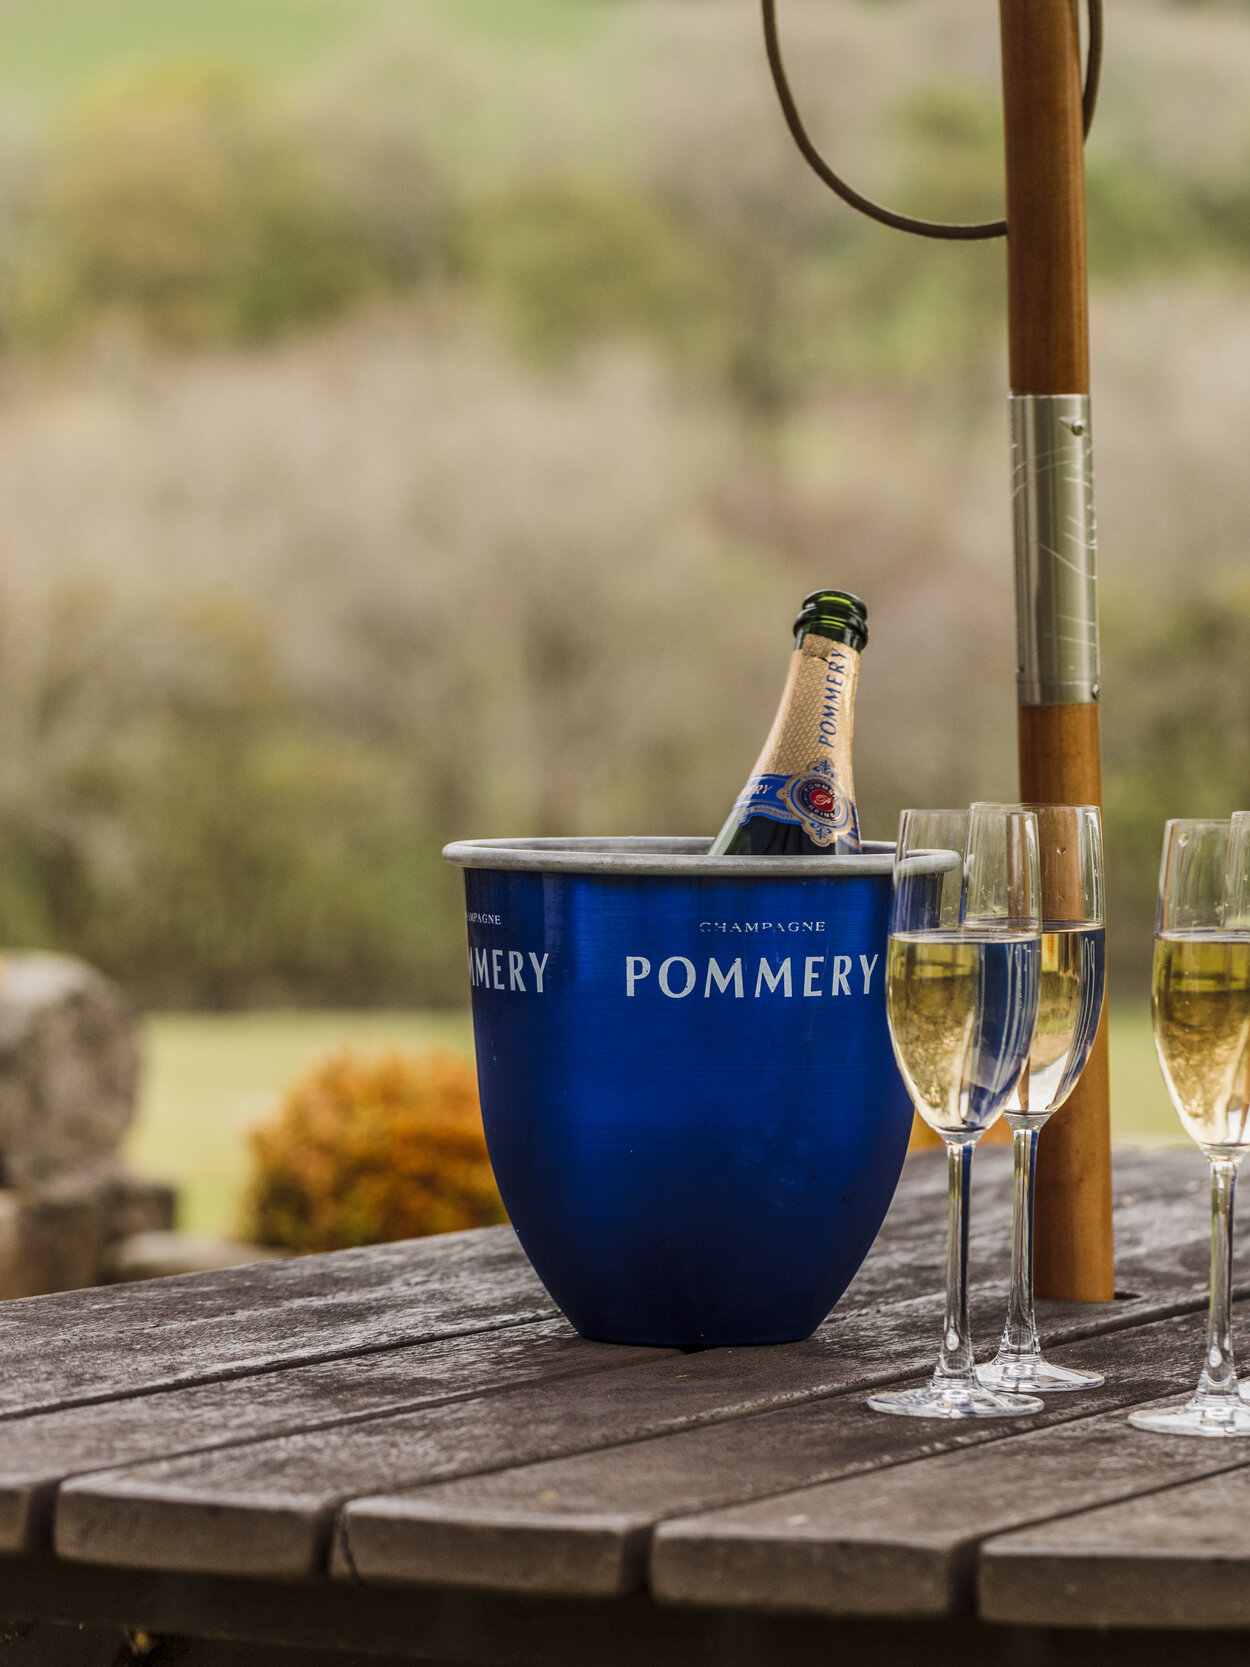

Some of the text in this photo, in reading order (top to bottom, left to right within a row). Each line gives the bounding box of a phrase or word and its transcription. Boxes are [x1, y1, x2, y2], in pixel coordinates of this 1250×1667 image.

[817, 648, 847, 749] POMMERY
[698, 921, 826, 933] CHAMPAGNE
[625, 953, 879, 999] POMMERY
